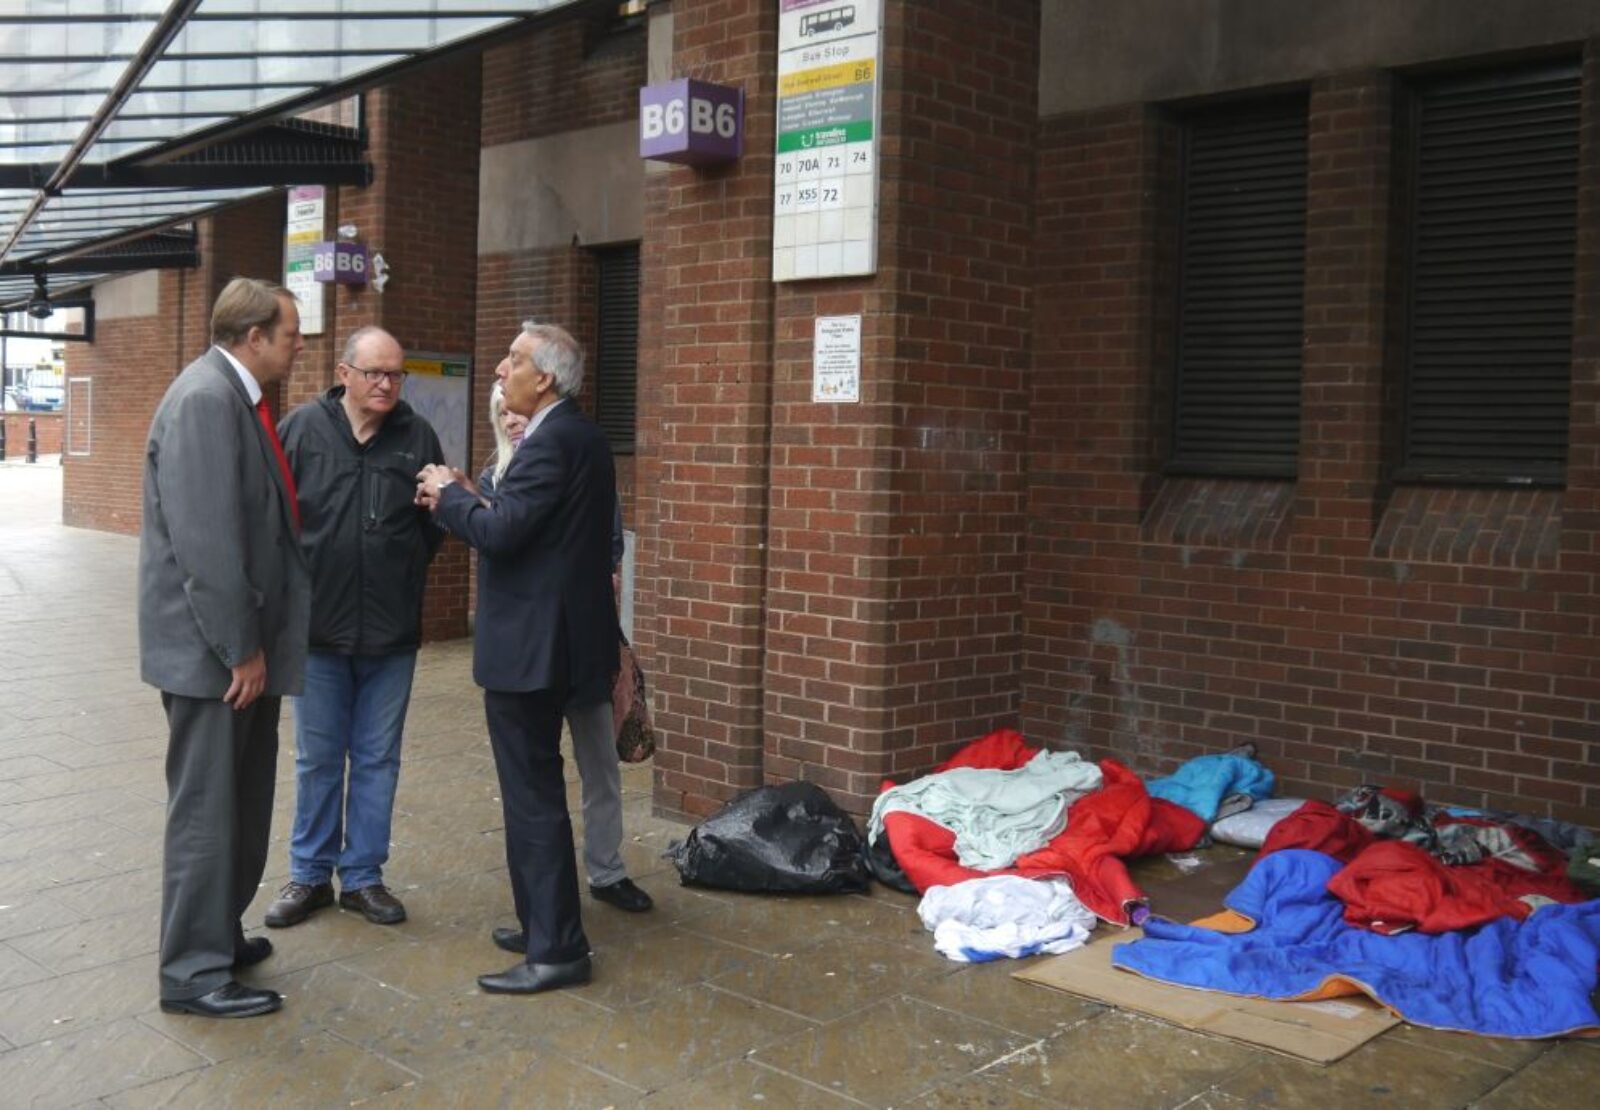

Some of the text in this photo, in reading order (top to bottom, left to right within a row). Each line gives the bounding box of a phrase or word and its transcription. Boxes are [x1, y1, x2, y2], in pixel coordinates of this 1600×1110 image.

[824, 46, 850, 58] Stop
[855, 67, 871, 81] B6
[643, 99, 684, 139] B6
[691, 97, 736, 138] B6
[780, 152, 866, 174] 70 70A 71 74
[780, 188, 838, 205] 77 X55 72
[315, 253, 334, 272] B6
[336, 252, 365, 273] B6
